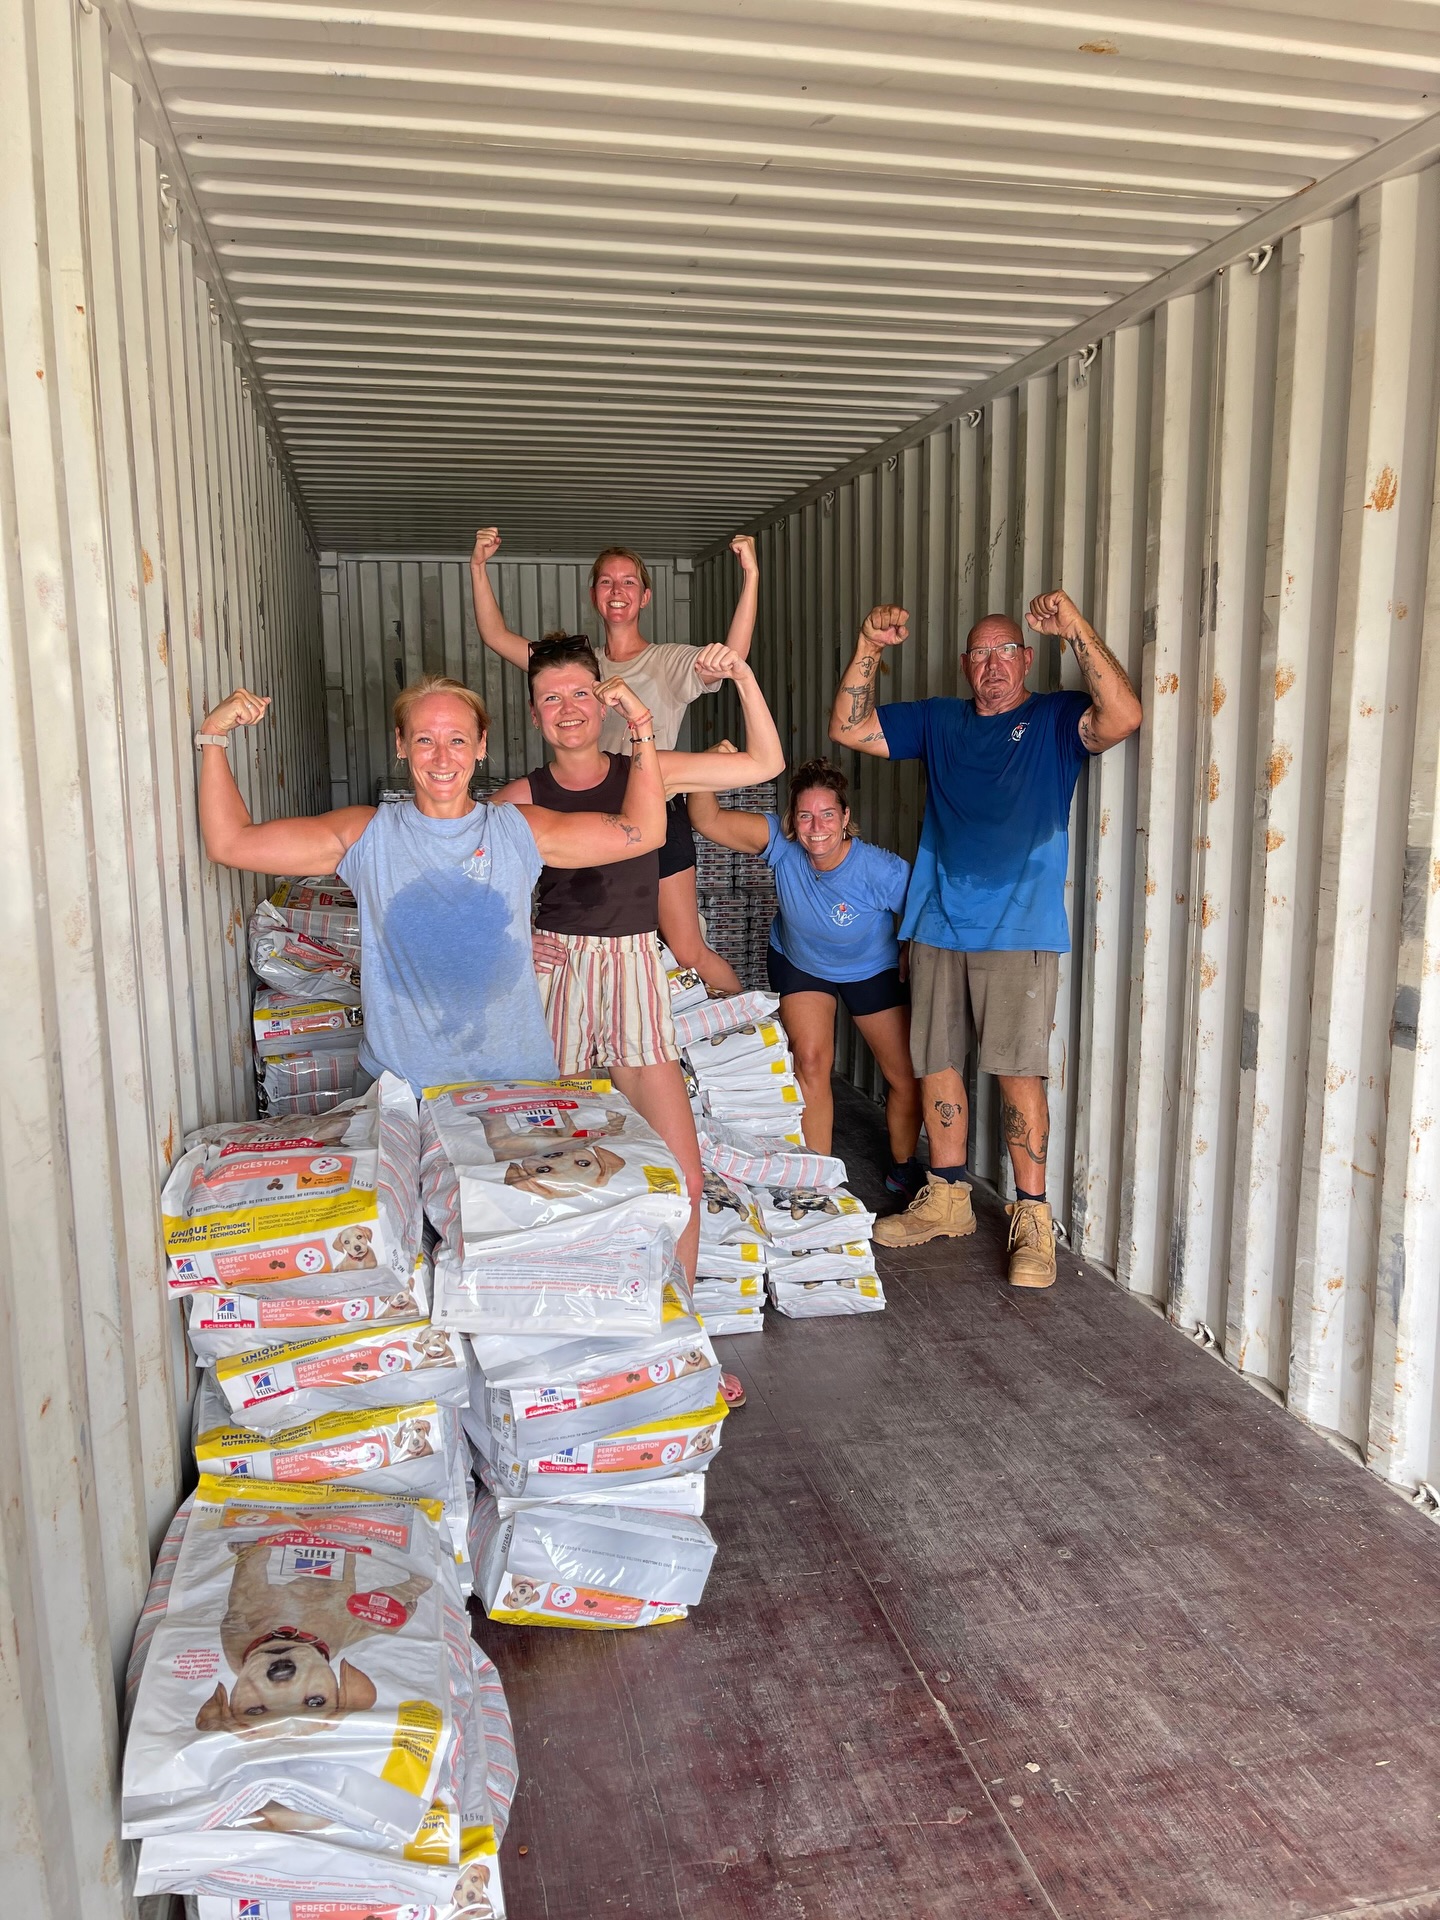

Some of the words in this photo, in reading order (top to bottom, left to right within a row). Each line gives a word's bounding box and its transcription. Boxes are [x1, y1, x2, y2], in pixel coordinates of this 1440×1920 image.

[495, 1105, 523, 1113] PLAN
[284, 1139, 318, 1148] PLAN
[230, 1158, 289, 1171] DIGESTION
[171, 1225, 207, 1238] UNIQUE
[210, 1222, 250, 1233] ACTIVBIOME+
[210, 1228, 251, 1240] TECHNOLOGY
[168, 1234, 207, 1245] NUTRITION
[217, 1253, 248, 1264] PERFECT
[249, 1248, 289, 1260] DIGESTION
[219, 1263, 238, 1271] PUPPY
[179, 1272, 199, 1281] Hill's
[262, 1300, 295, 1308] PERFECT
[217, 1311, 237, 1320] Hill's
[241, 1343, 284, 1363] UNIQUE
[288, 1335, 332, 1352] TECHNOLOGY
[297, 1359, 330, 1373] PERFECT
[332, 1349, 372, 1364] DIGESTION
[299, 1369, 319, 1379] PUPPY
[256, 1387, 276, 1397] Hill's
[540, 1394, 559, 1402] Hill's
[597, 1446, 625, 1454] PERFECT
[626, 1441, 660, 1452] DIGESTION
[275, 1453, 308, 1465] PERFECT
[555, 1454, 573, 1463] Hill's
[276, 1463, 296, 1471] PUPPY
[541, 1464, 567, 1472] SCIENCE
[568, 1464, 586, 1472] PLAN
[368, 1525, 402, 1537] PUPPY
[265, 1536, 303, 1545] PLAN
[357, 1611, 391, 1624] NEW
[573, 1609, 609, 1619] DIGESTION
[461, 1812, 475, 1823] 14.5
[422, 1821, 445, 1830] UNIQ
[295, 1903, 337, 1913] PERFECT
